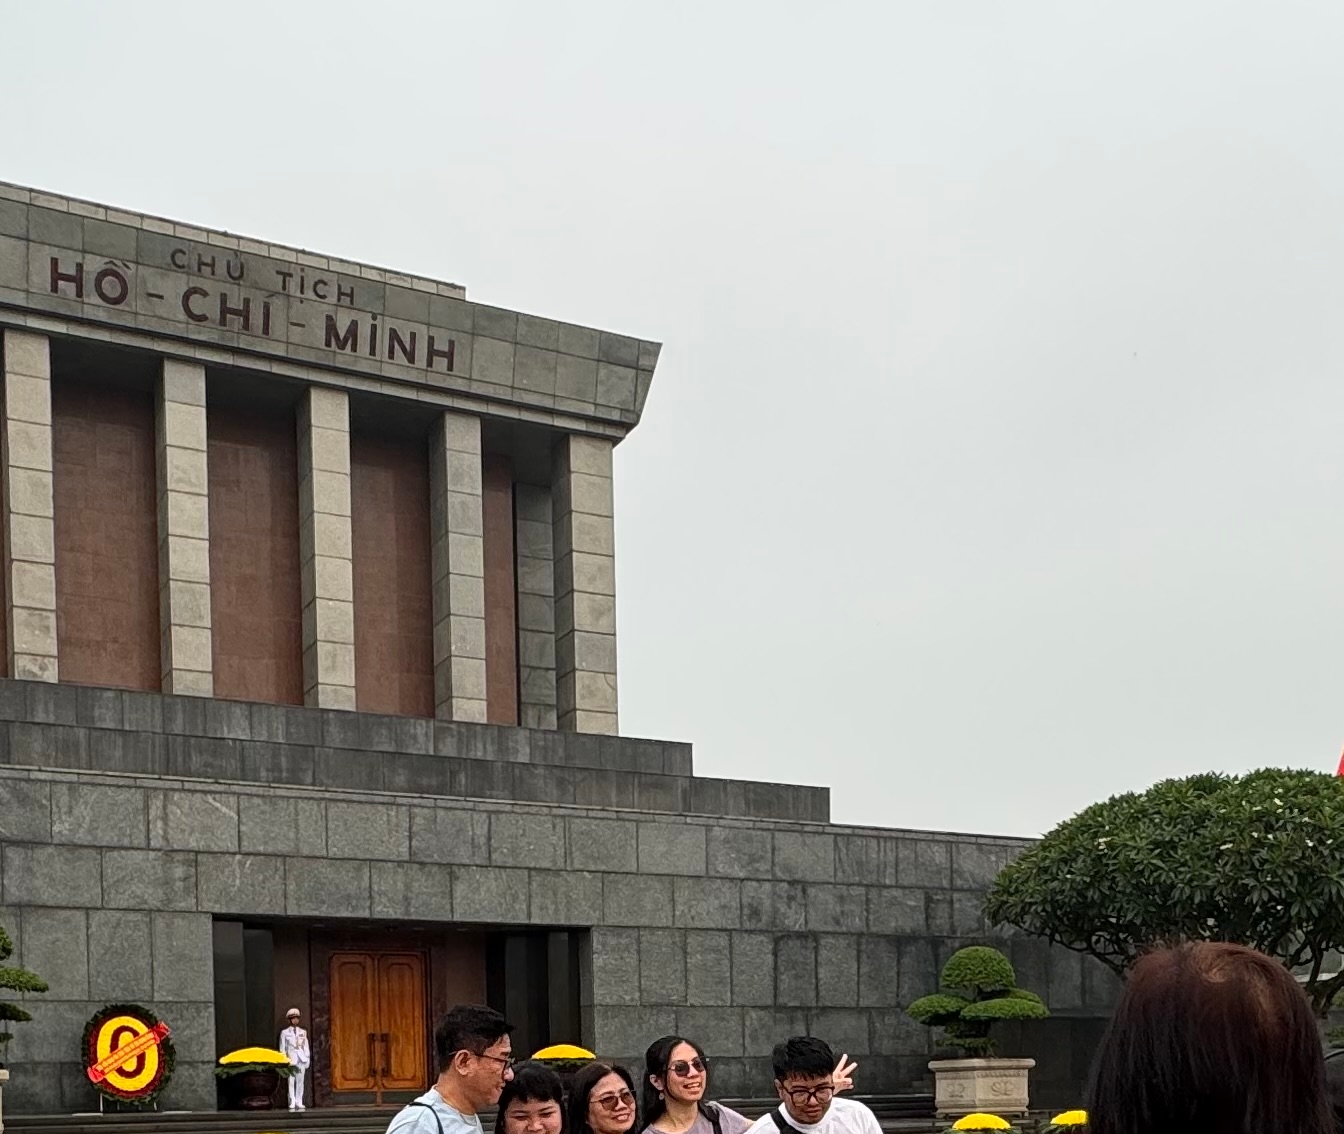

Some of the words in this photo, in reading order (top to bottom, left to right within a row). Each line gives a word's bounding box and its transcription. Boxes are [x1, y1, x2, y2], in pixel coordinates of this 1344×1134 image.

[170, 249, 245, 281] CHỦ
[50, 256, 132, 305] HỒ
[182, 286, 276, 336] CHÍ
